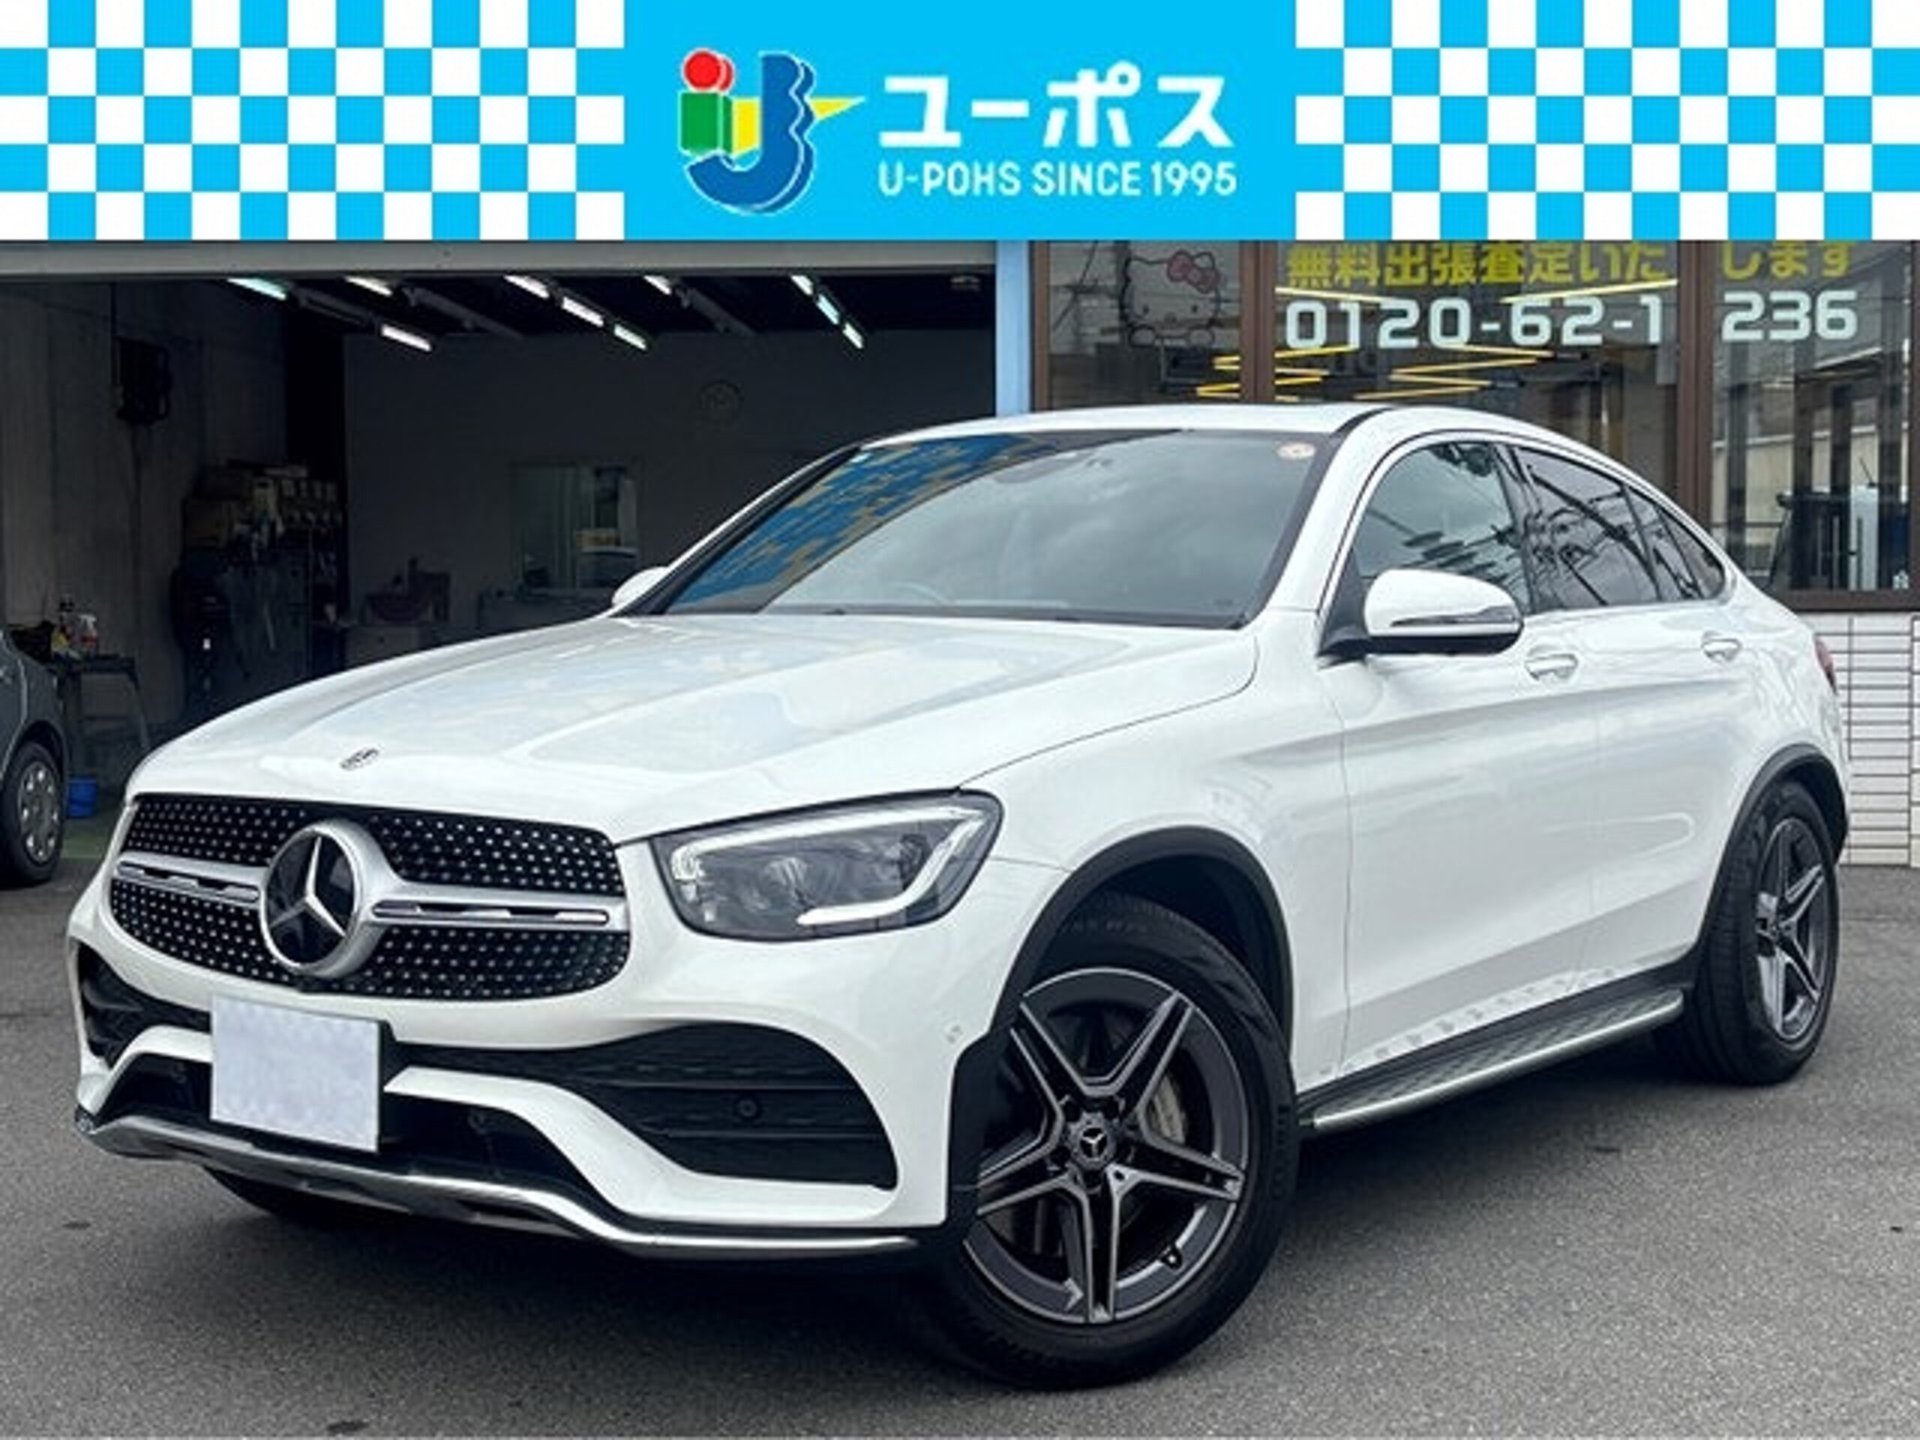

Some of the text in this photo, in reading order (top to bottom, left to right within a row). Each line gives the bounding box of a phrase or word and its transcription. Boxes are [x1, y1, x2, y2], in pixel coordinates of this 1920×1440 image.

[1288, 240, 1855, 288] 無料出張査定いた します
[1286, 290, 1858, 349] 0120-62-1 236
